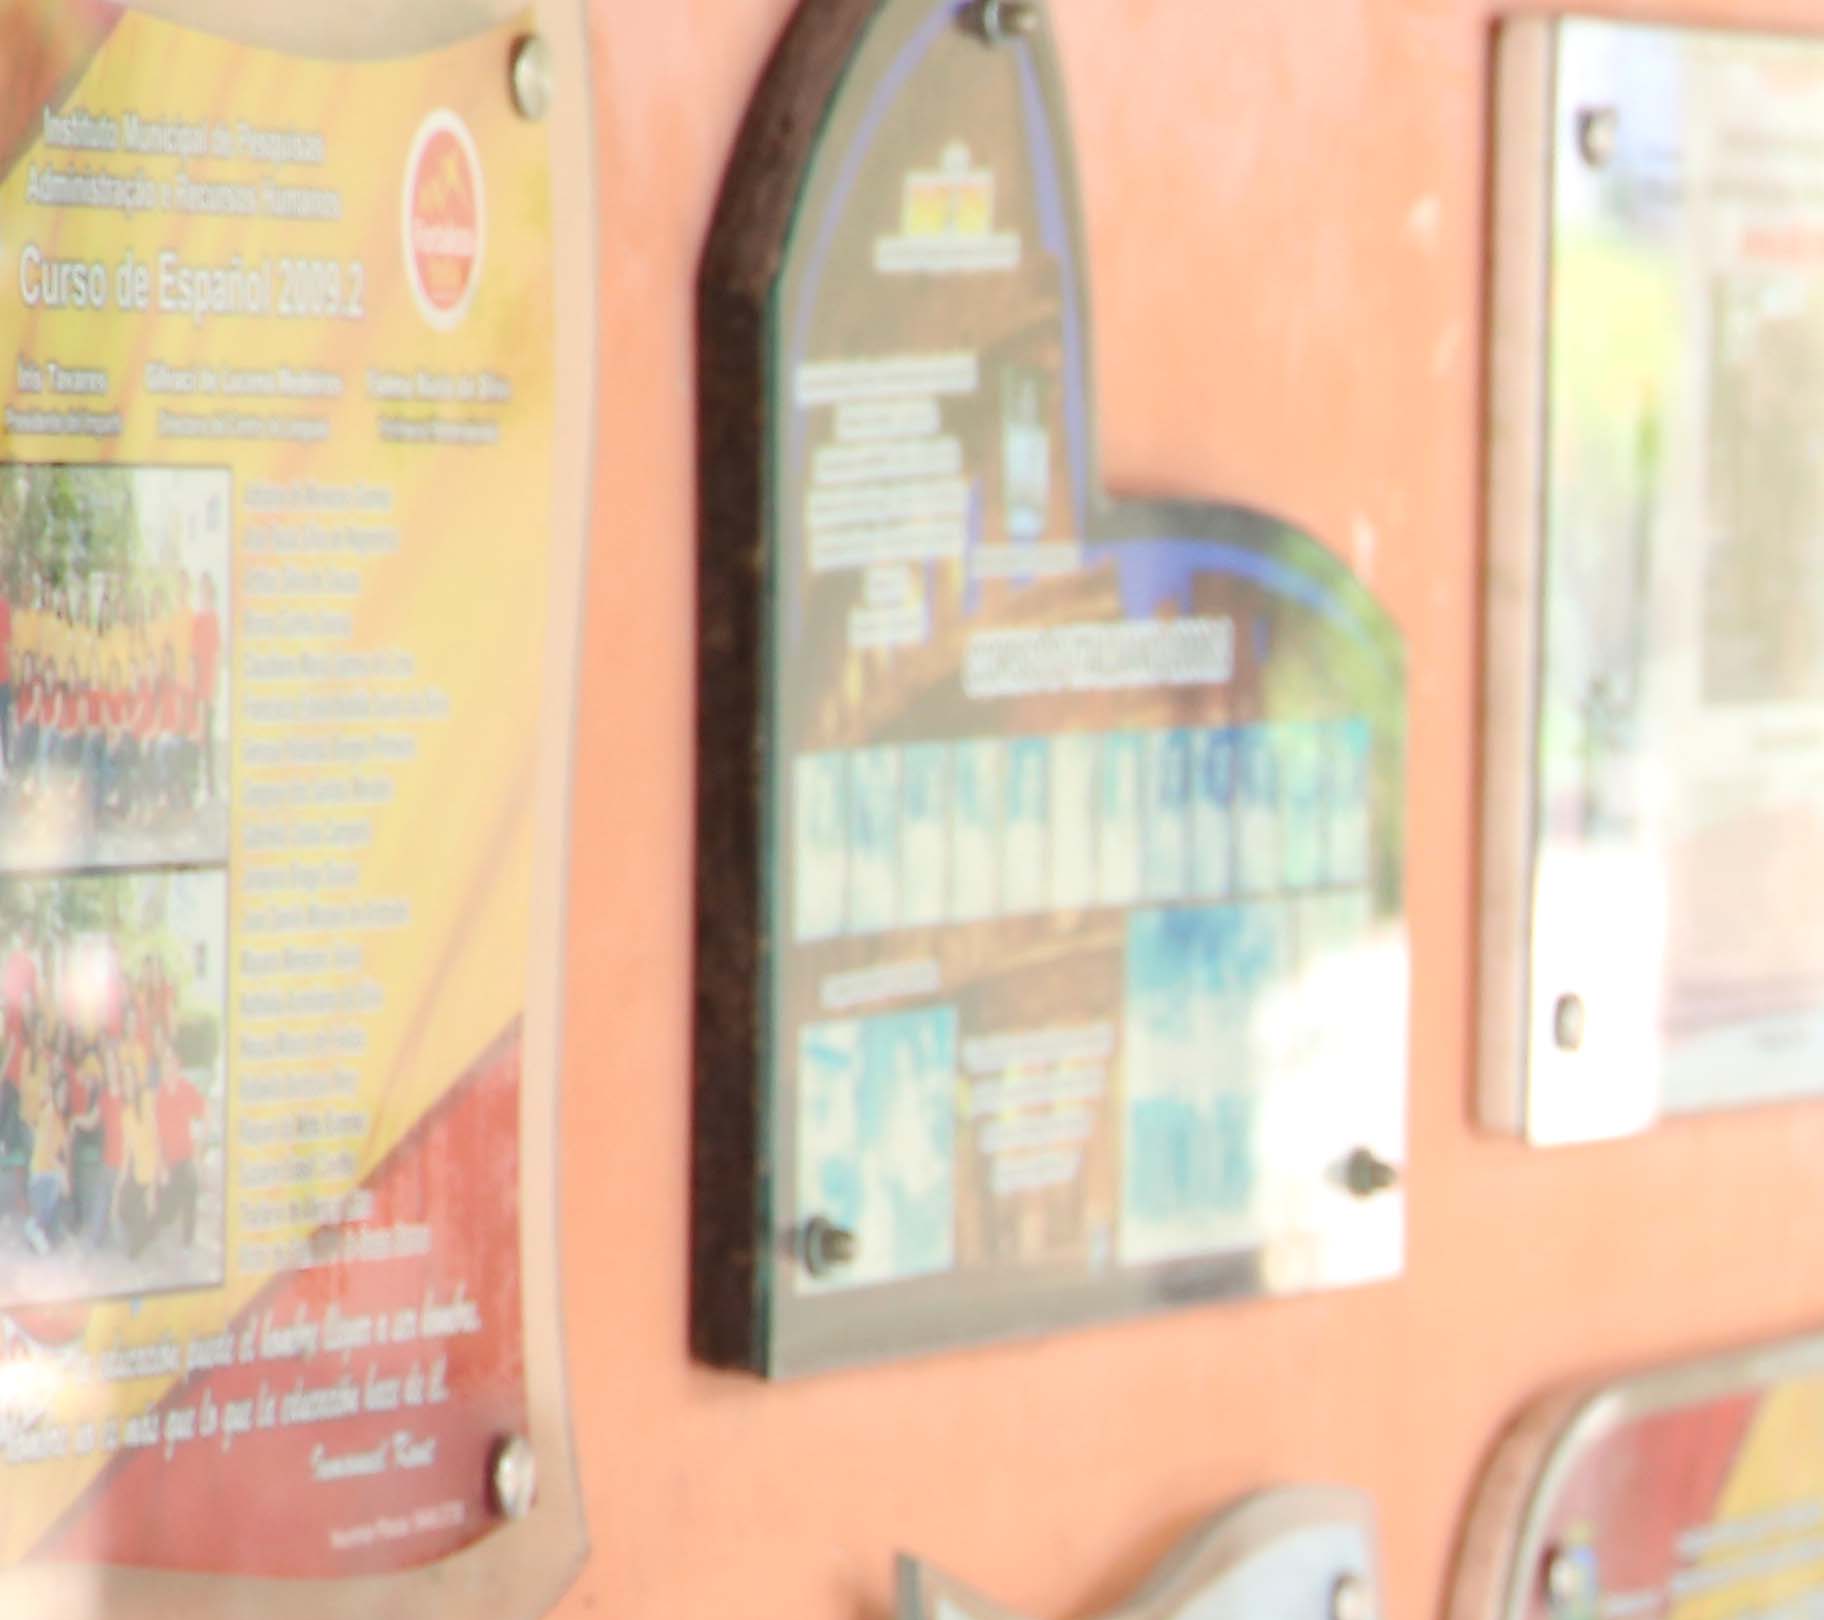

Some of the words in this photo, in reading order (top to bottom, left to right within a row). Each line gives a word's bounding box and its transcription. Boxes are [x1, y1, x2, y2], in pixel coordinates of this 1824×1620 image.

[20, 242, 107, 311] Curso
[117, 249, 150, 312] de
[158, 250, 272, 327] Español
